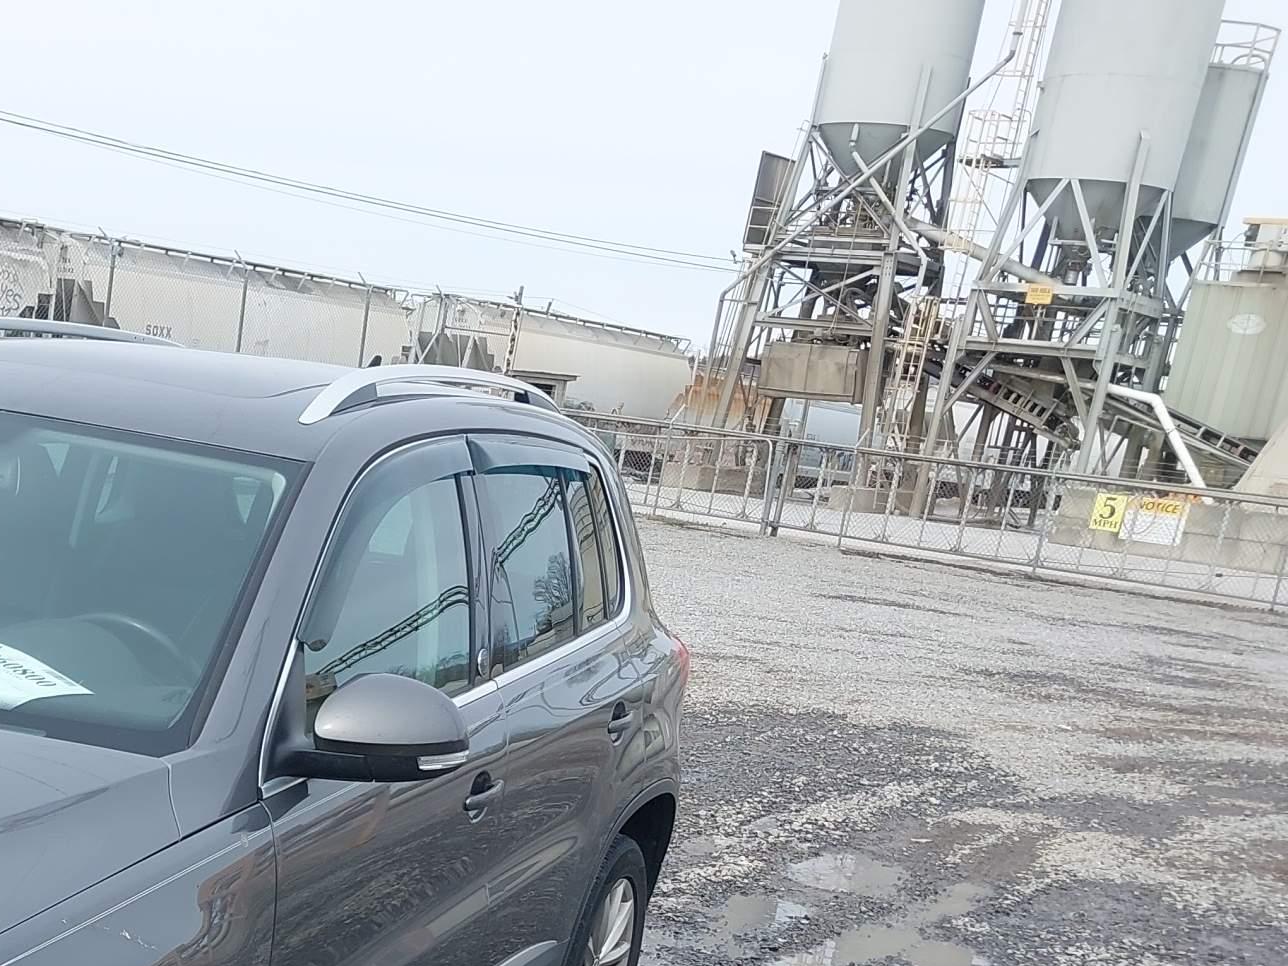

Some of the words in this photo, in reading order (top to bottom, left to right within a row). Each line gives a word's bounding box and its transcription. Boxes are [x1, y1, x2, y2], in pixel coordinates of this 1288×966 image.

[145, 324, 173, 338] SOXX
[1098, 496, 1117, 520] 5
[1093, 518, 1118, 529] MPH
